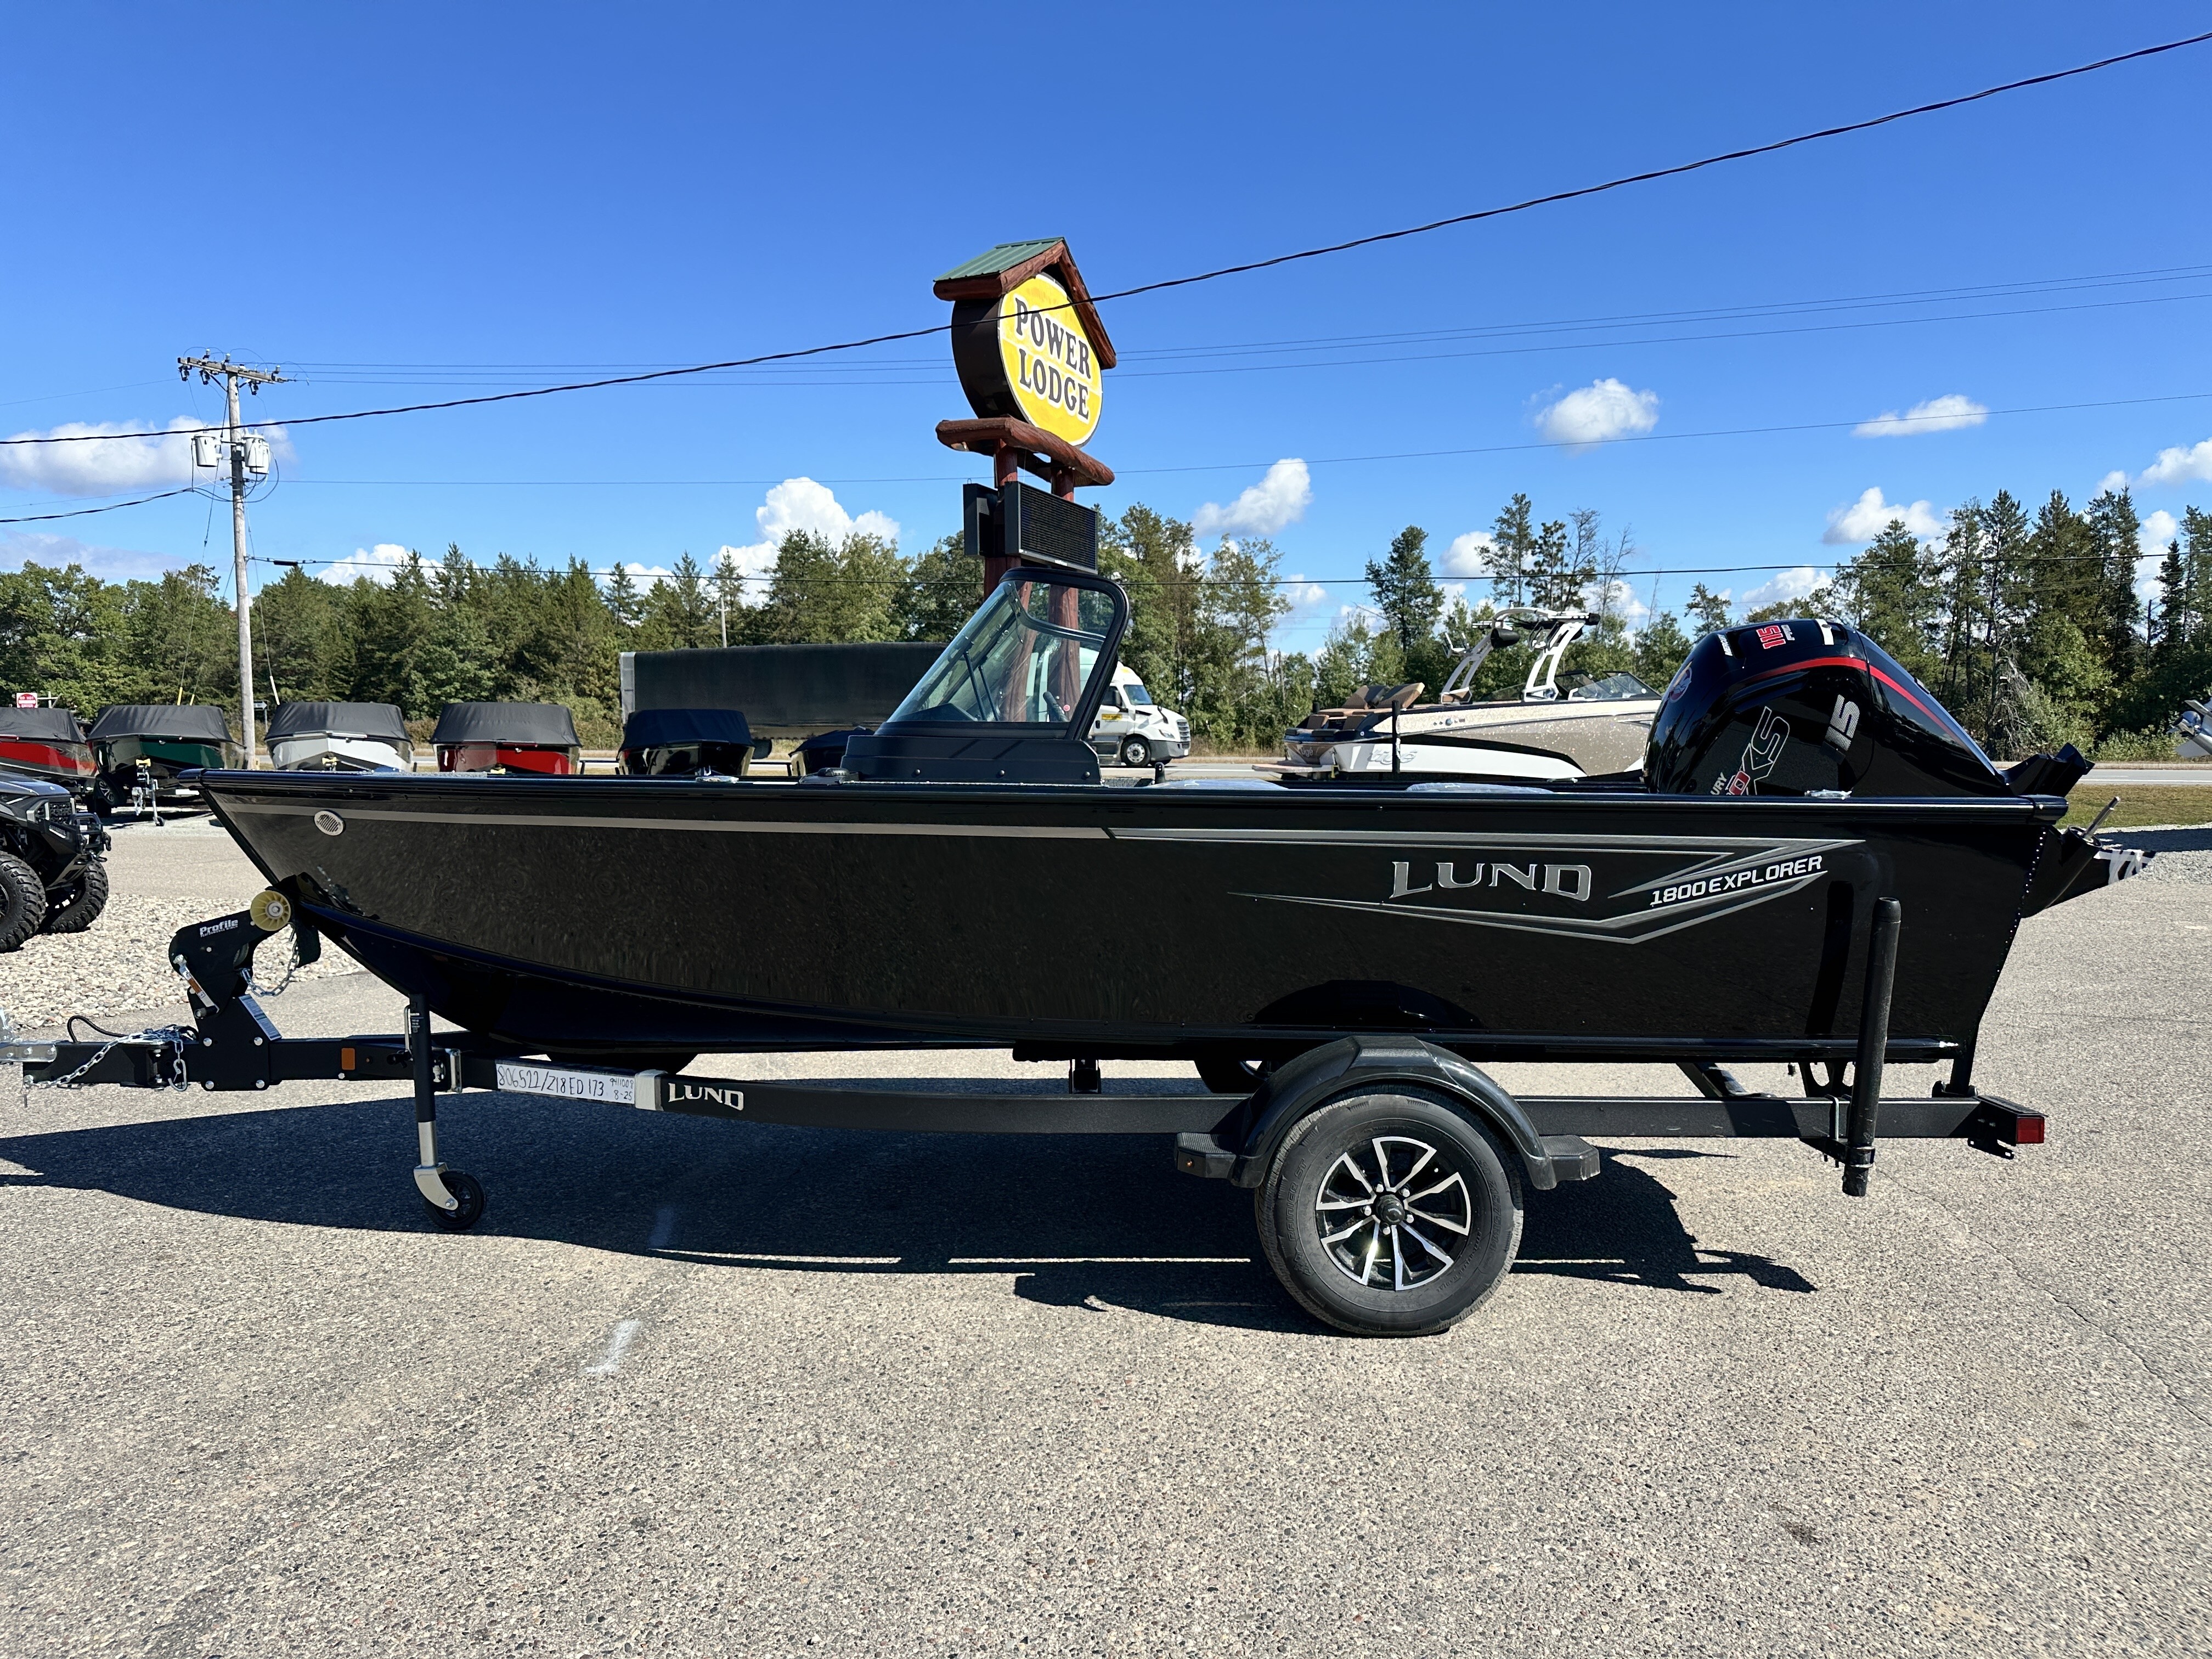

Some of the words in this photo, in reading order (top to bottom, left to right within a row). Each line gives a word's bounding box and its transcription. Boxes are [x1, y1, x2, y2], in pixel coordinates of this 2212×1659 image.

[1015, 297, 1091, 380] POWER
[1019, 348, 1089, 420] LODGE
[1756, 625, 1786, 649] 115
[1389, 861, 1592, 902] LUND
[1650, 881, 1706, 906] 1800
[1708, 855, 1823, 893] EXPLORER
[200, 919, 239, 935] Profile
[668, 1082, 744, 1111] LUND
[1286, 1182, 1298, 1242] RAINIER
